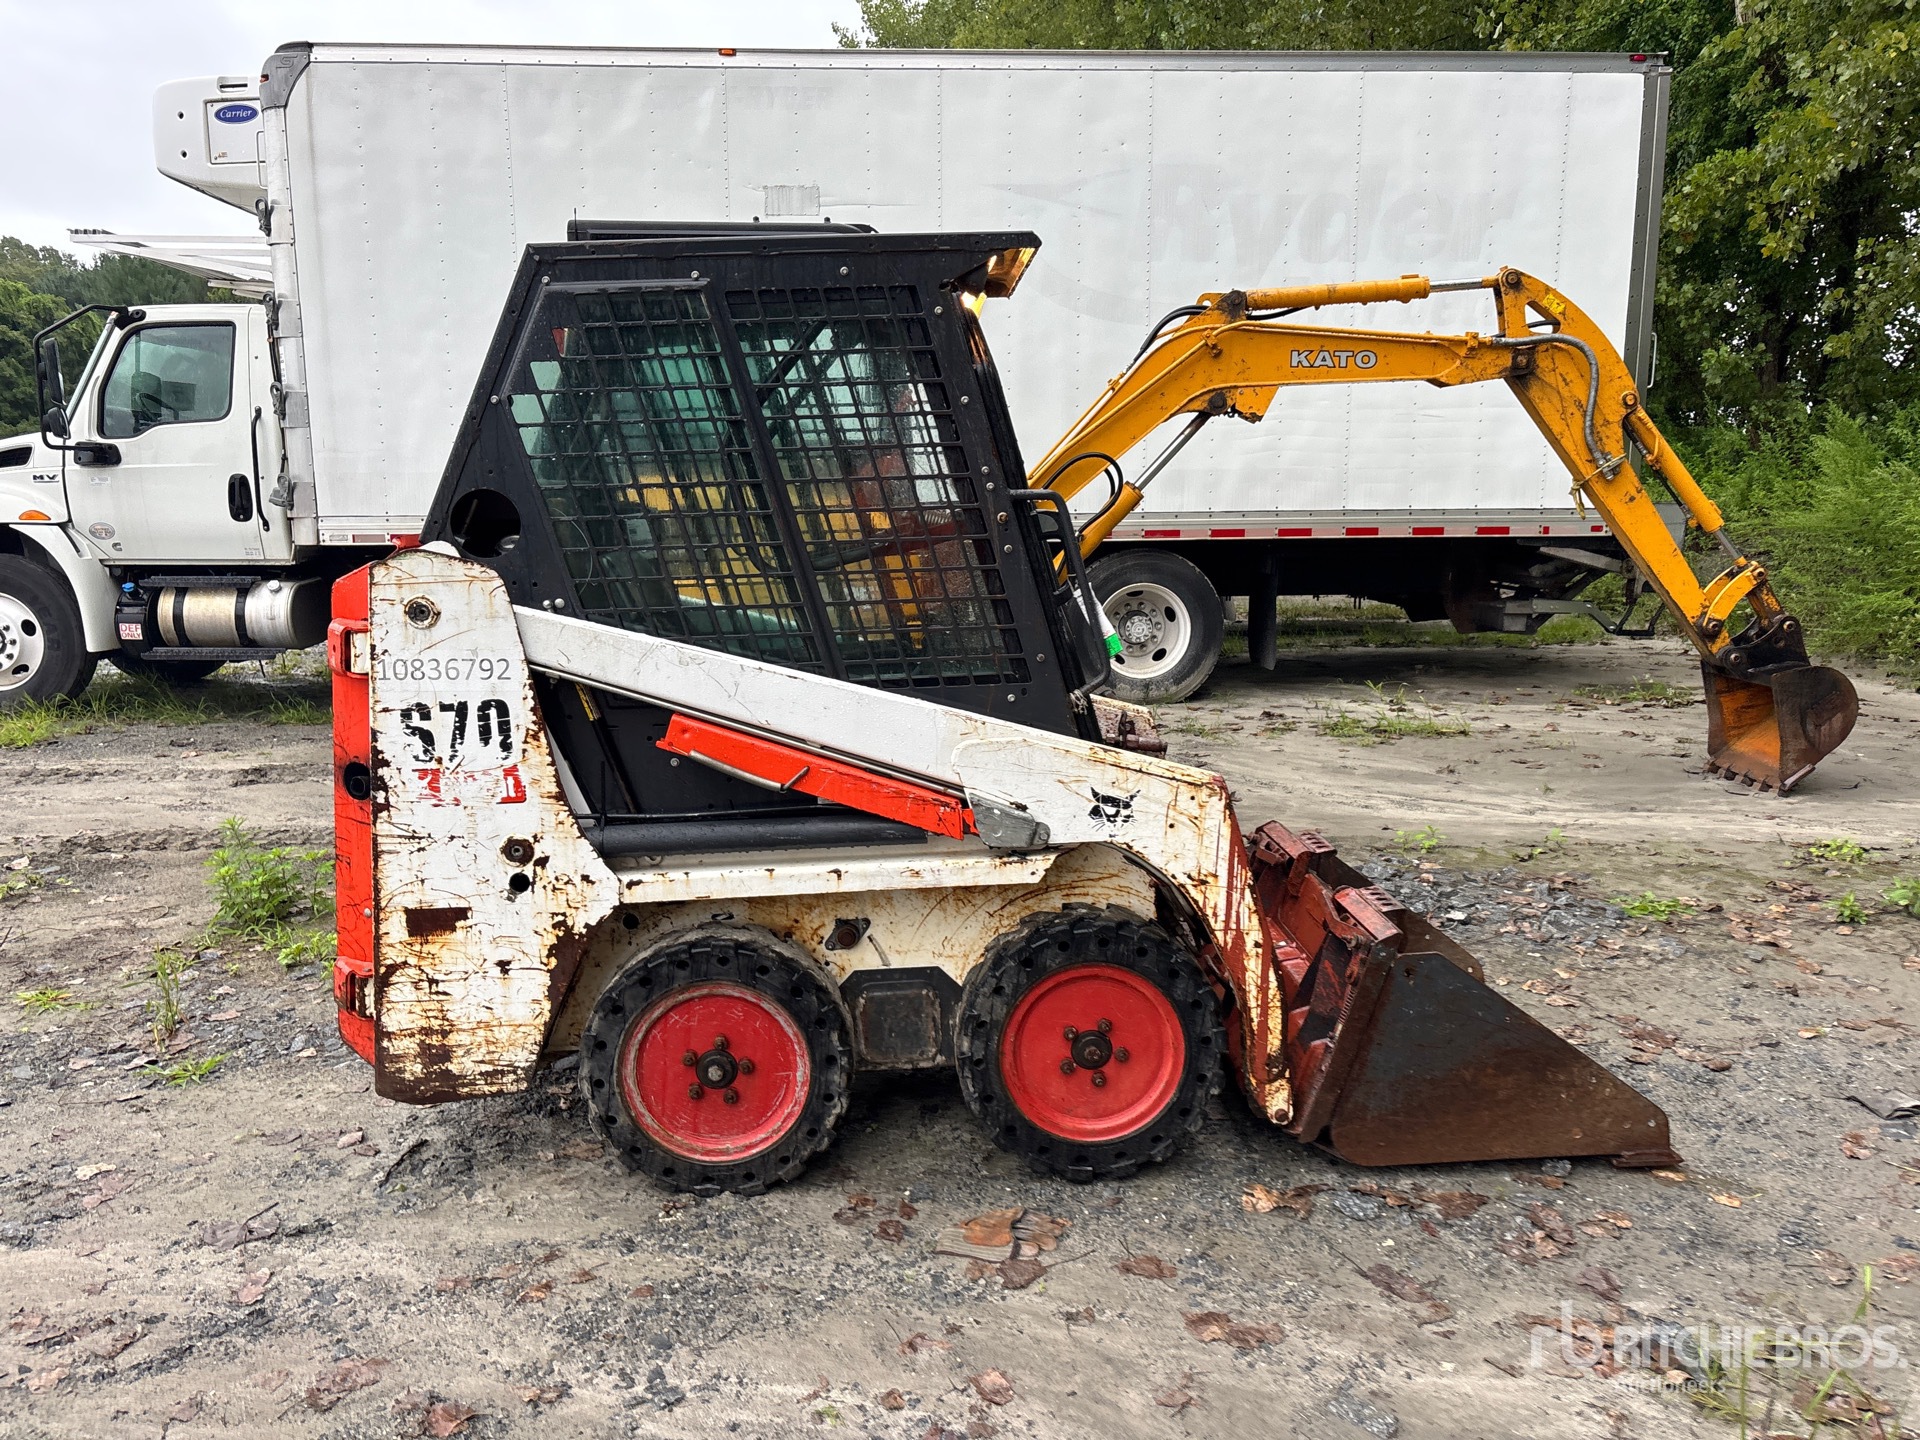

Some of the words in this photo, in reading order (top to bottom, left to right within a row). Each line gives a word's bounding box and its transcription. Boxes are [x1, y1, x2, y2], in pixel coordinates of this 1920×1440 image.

[220, 109, 253, 118] Carrier
[1290, 349, 1378, 369] KATO
[120, 624, 141, 632] DEF
[377, 658, 512, 681] 10836792
[400, 698, 513, 764] S70
